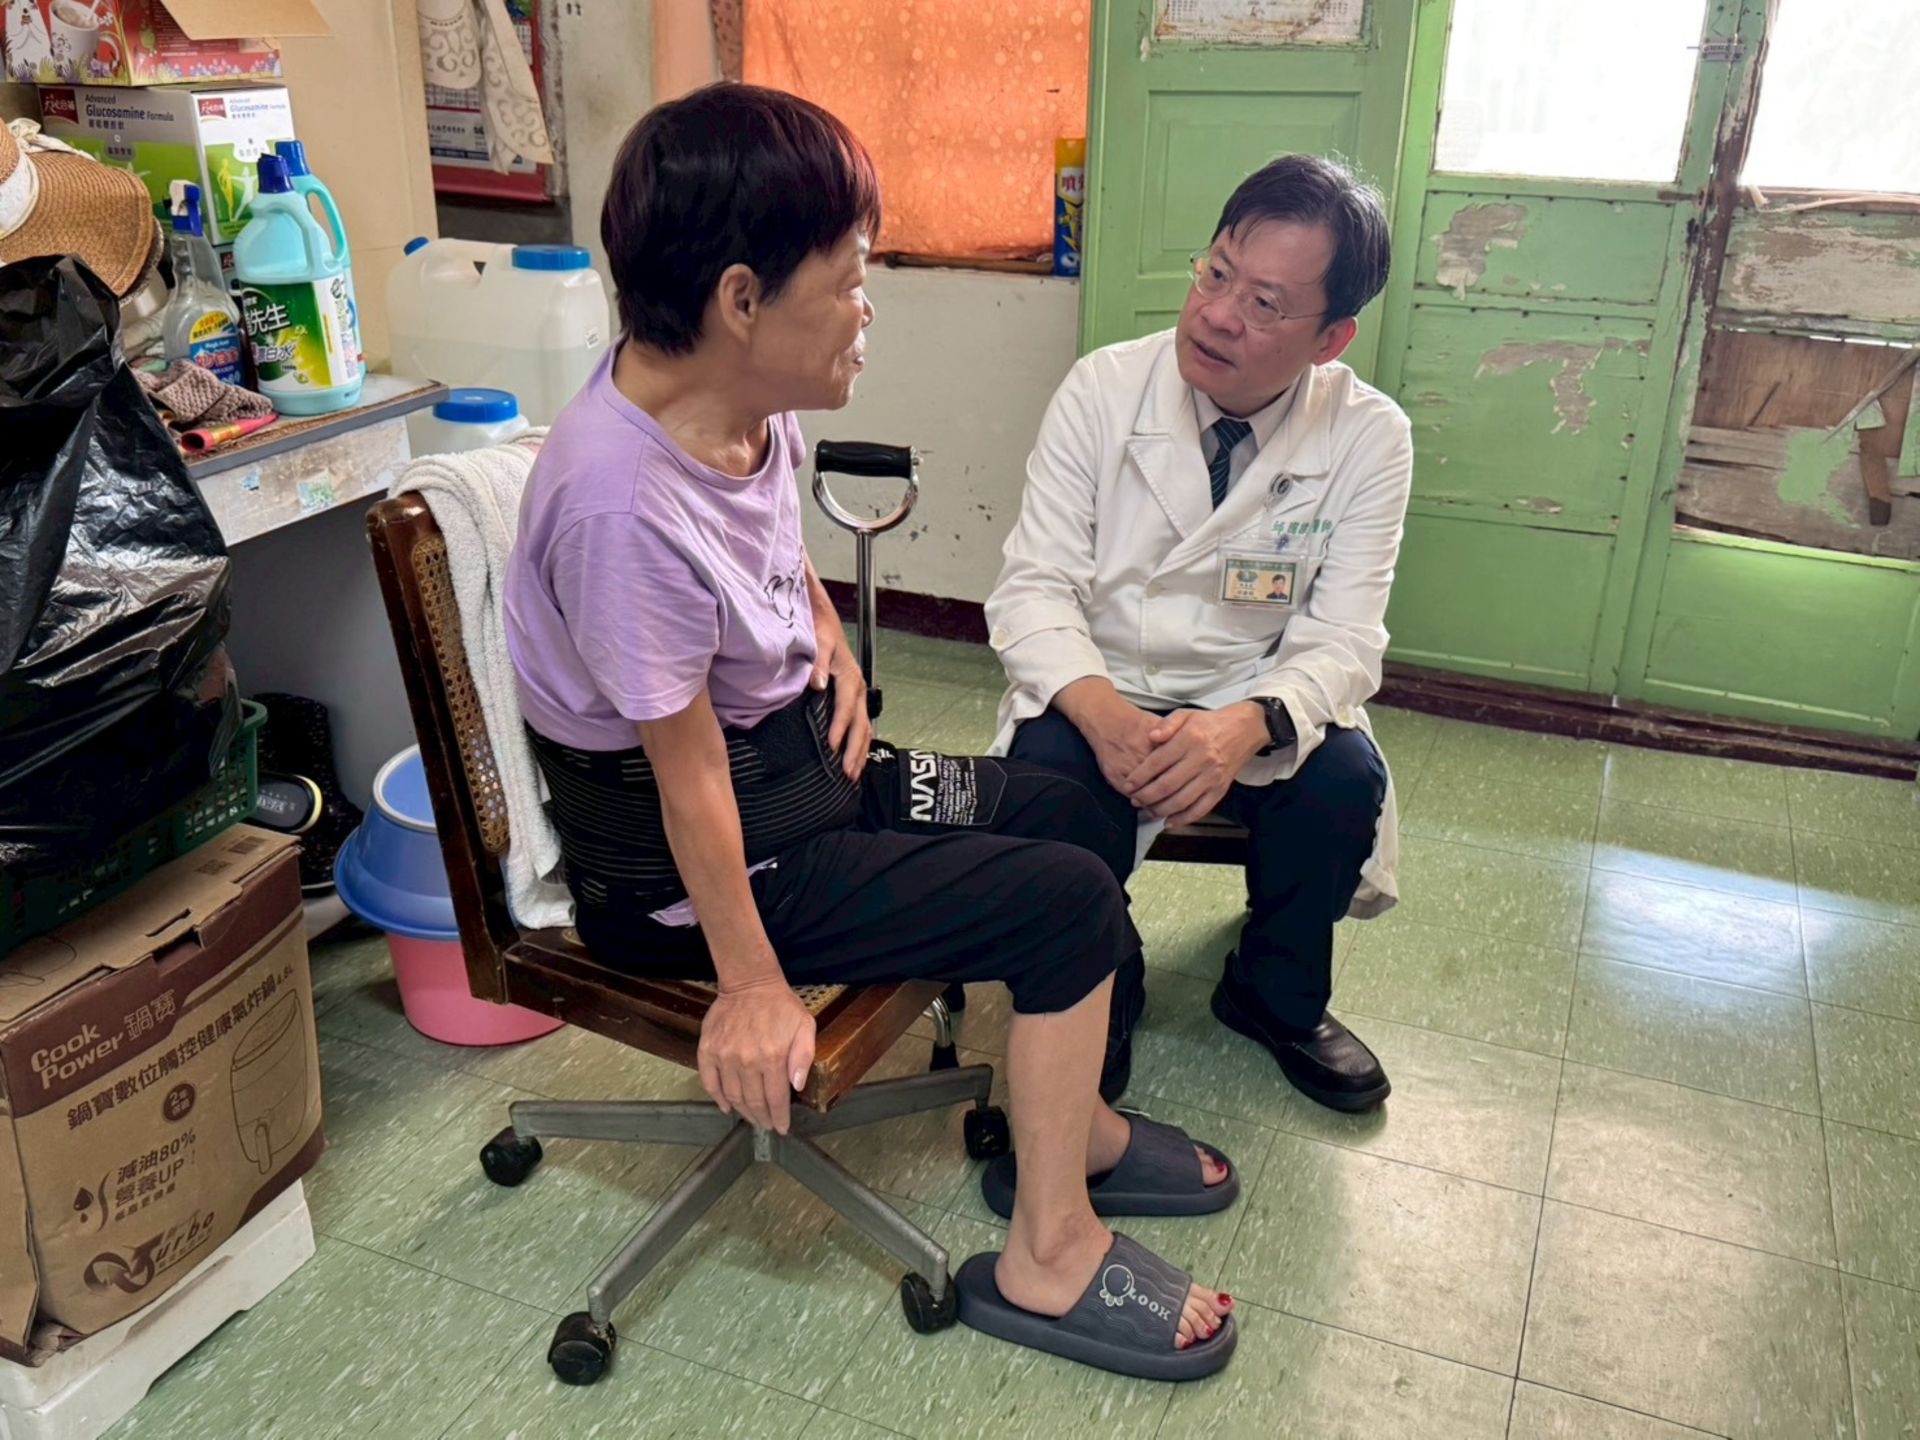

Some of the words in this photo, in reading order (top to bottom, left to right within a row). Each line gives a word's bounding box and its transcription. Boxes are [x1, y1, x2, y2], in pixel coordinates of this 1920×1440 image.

[85, 94, 117, 104] Advanced
[86, 104, 145, 120] Glucosamine
[146, 110, 174, 122] Formula
[124, 988, 177, 1042] 鍋寶
[30, 1023, 101, 1074] Cook
[41, 1032, 124, 1090] Power
[117, 1128, 196, 1185] 減油80%
